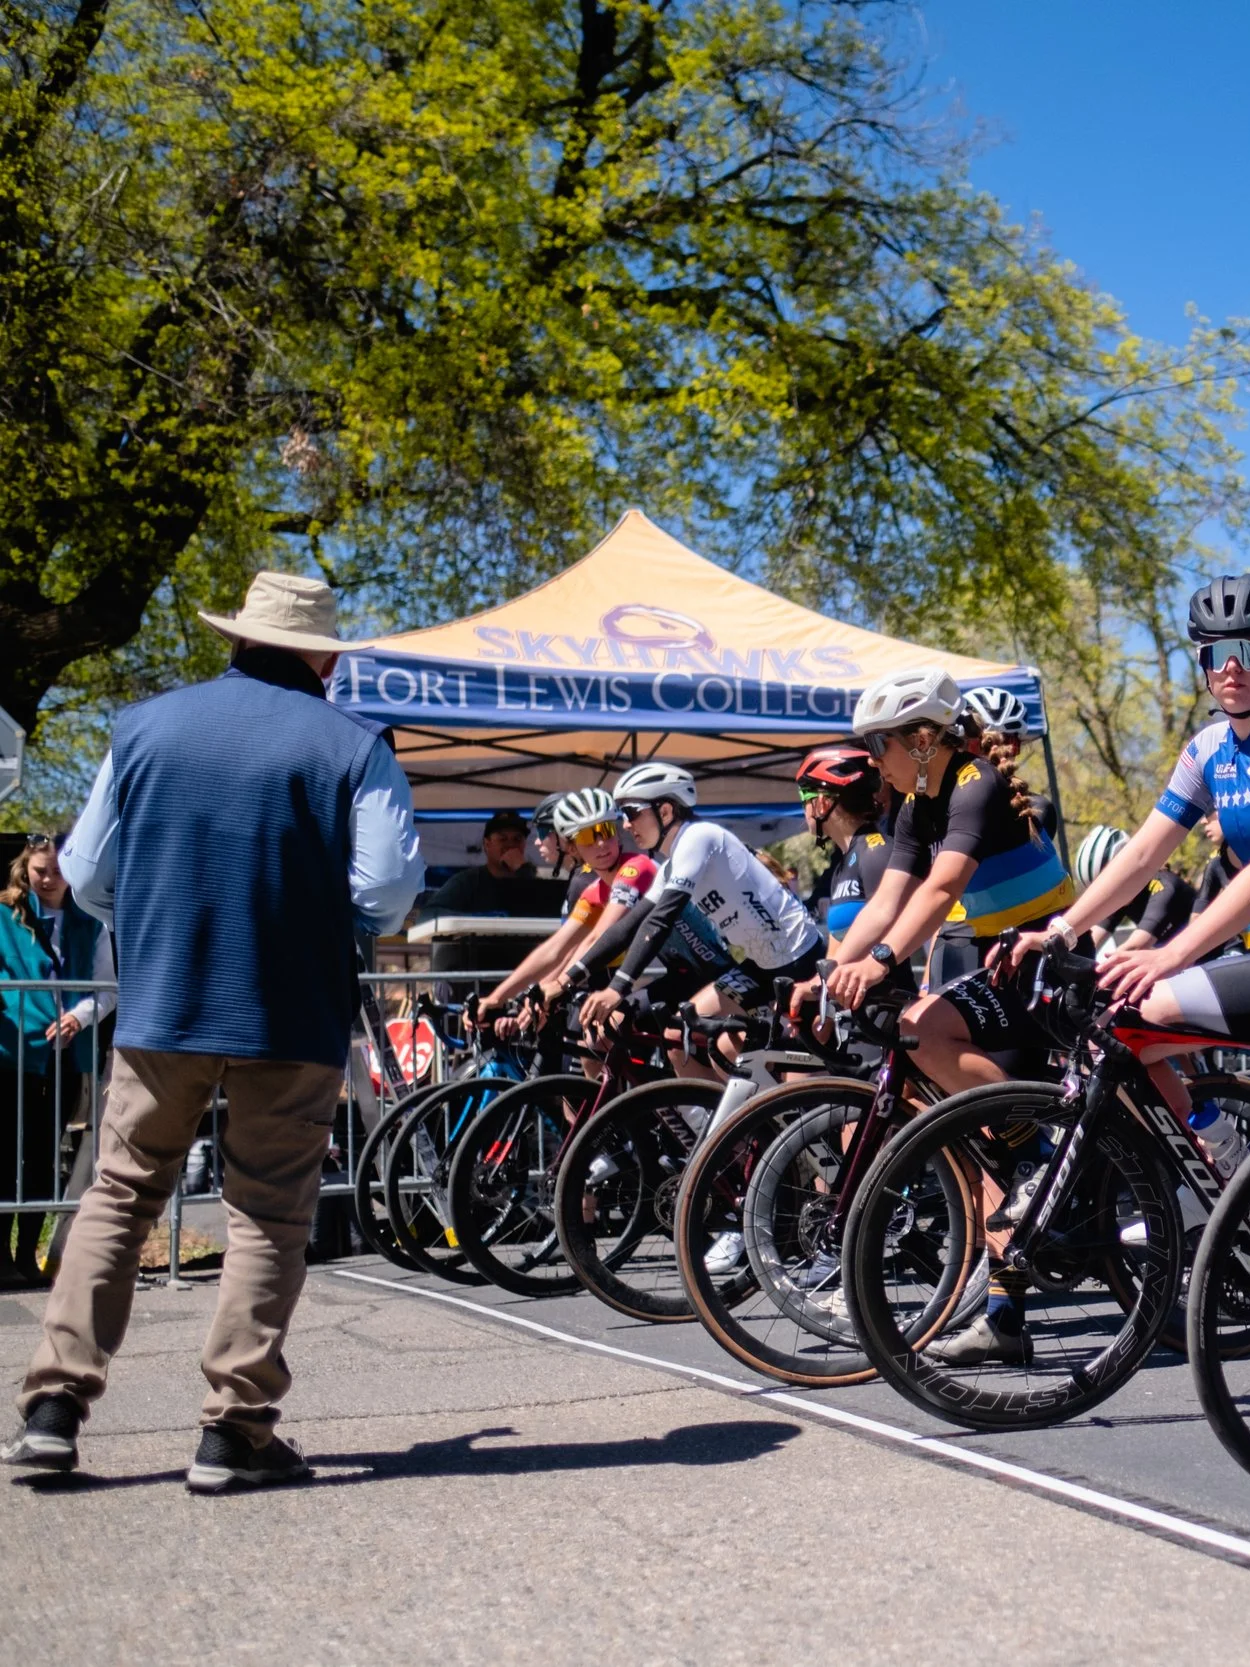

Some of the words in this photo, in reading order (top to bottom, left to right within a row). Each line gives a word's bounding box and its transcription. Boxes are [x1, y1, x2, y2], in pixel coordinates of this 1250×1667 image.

[473, 626, 864, 679] SKYHAWKS
[348, 657, 477, 708] FORT
[494, 664, 633, 713] LEWIS
[1036, 1123, 1084, 1232] SCOTT
